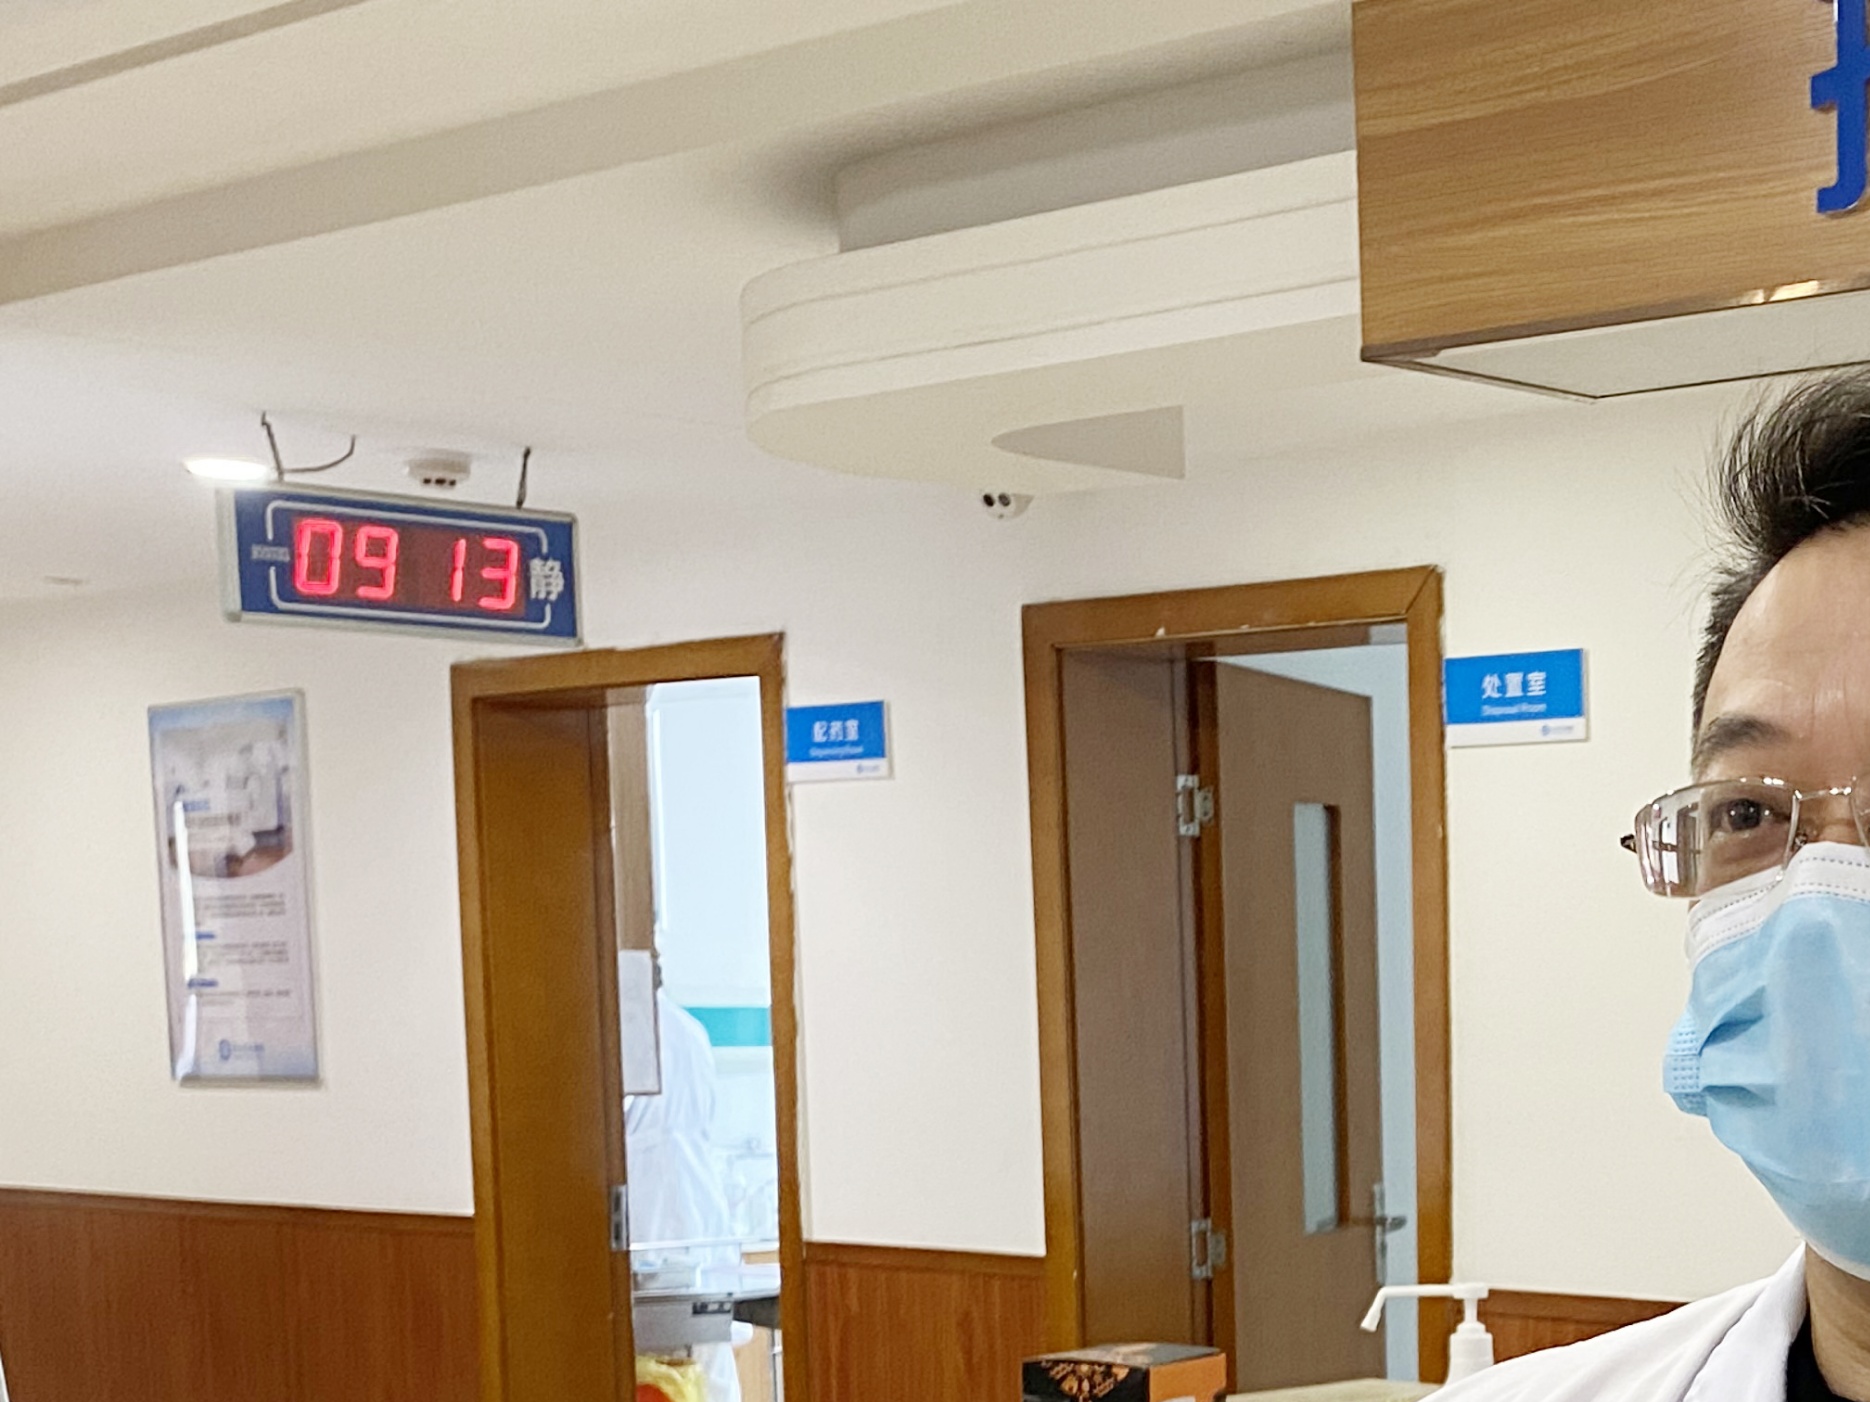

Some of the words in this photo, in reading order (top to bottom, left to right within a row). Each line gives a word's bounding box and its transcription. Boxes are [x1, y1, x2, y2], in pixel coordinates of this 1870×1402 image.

[294, 517, 400, 600] 09
[451, 537, 521, 611] 13
[529, 556, 565, 602] 静
